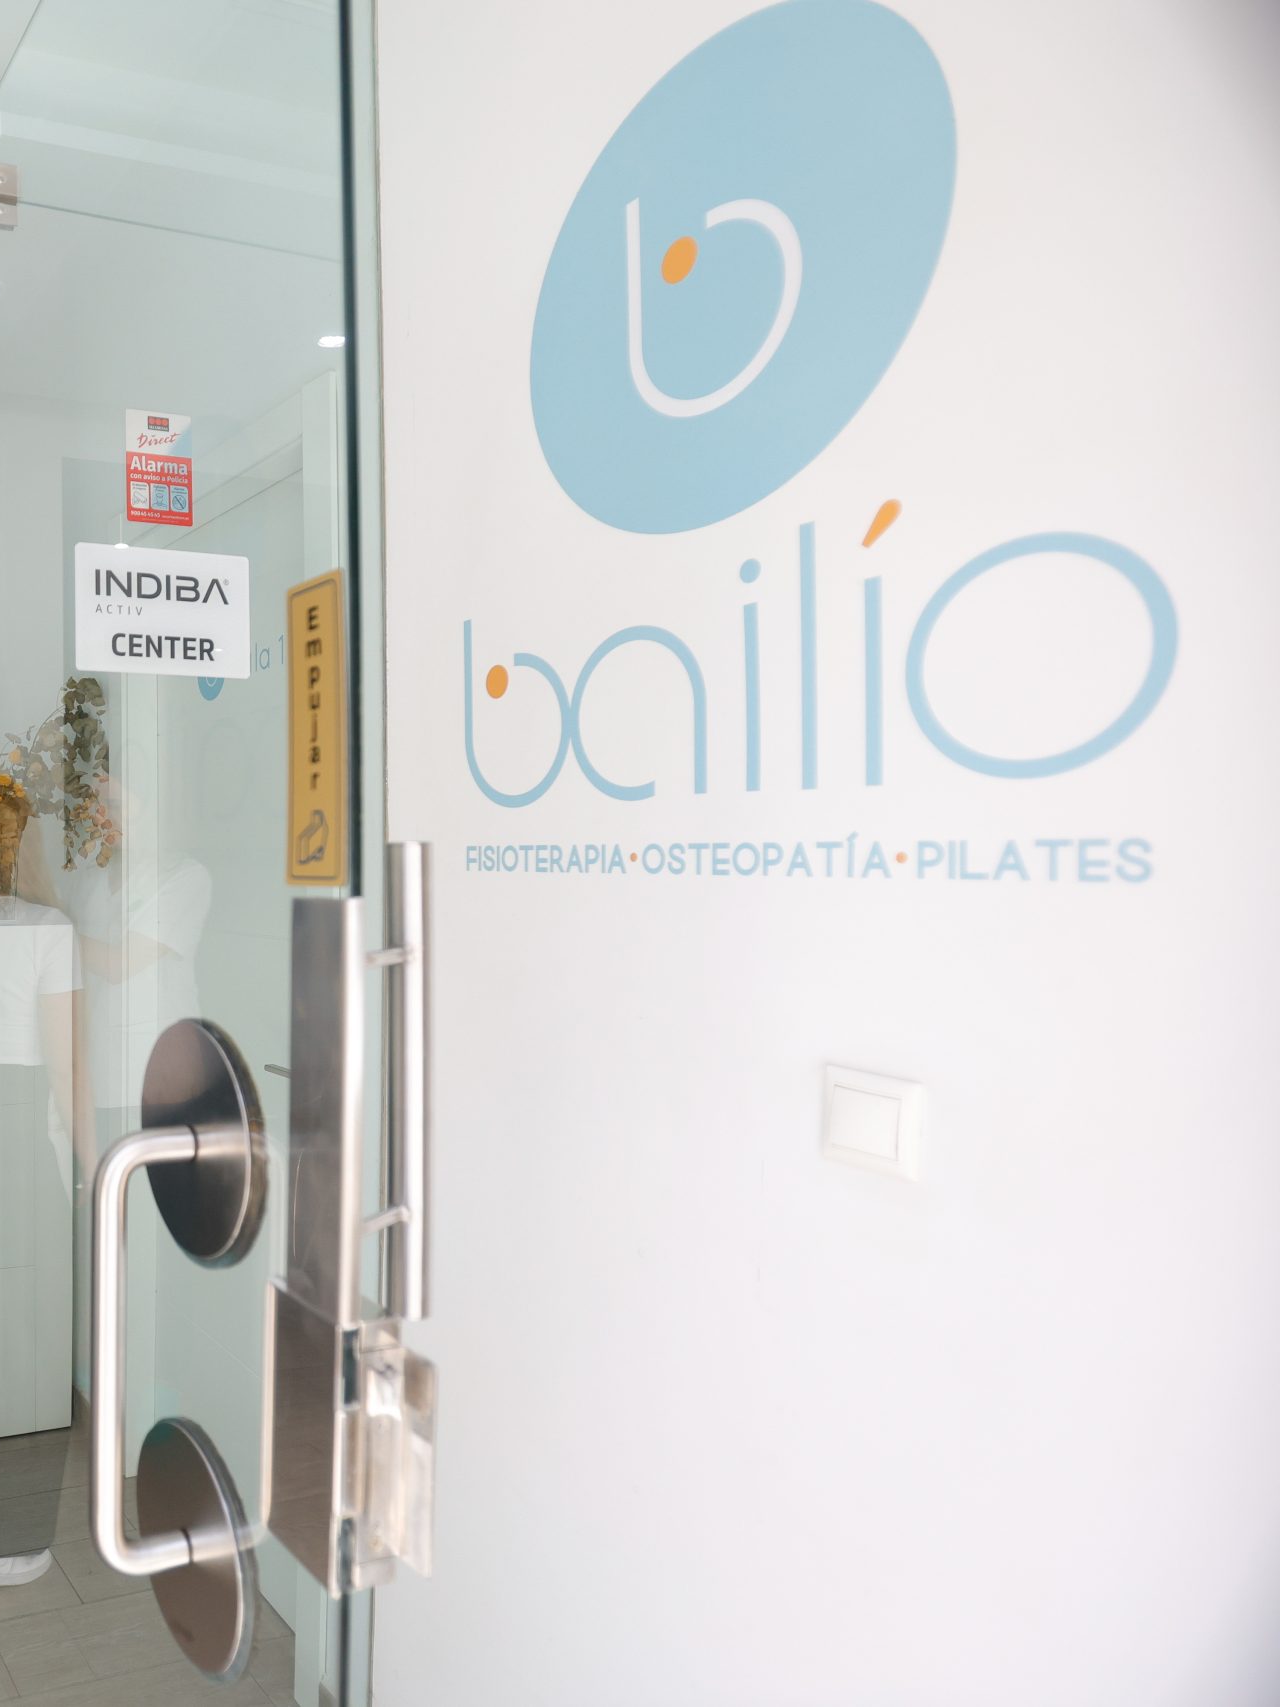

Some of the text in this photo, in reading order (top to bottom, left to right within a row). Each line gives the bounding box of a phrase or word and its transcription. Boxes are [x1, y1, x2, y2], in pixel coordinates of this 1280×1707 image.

[137, 432, 181, 448] Direct
[130, 456, 188, 475] Alarma
[143, 473, 160, 481] aviso
[95, 603, 143, 617] ACTIV
[111, 632, 215, 662] CENTER
[463, 498, 1180, 809] bailío
[304, 604, 323, 790] Empujar
[466, 831, 1154, 884] FISIOTERAPIA OSTEOPATÍA PILATES
